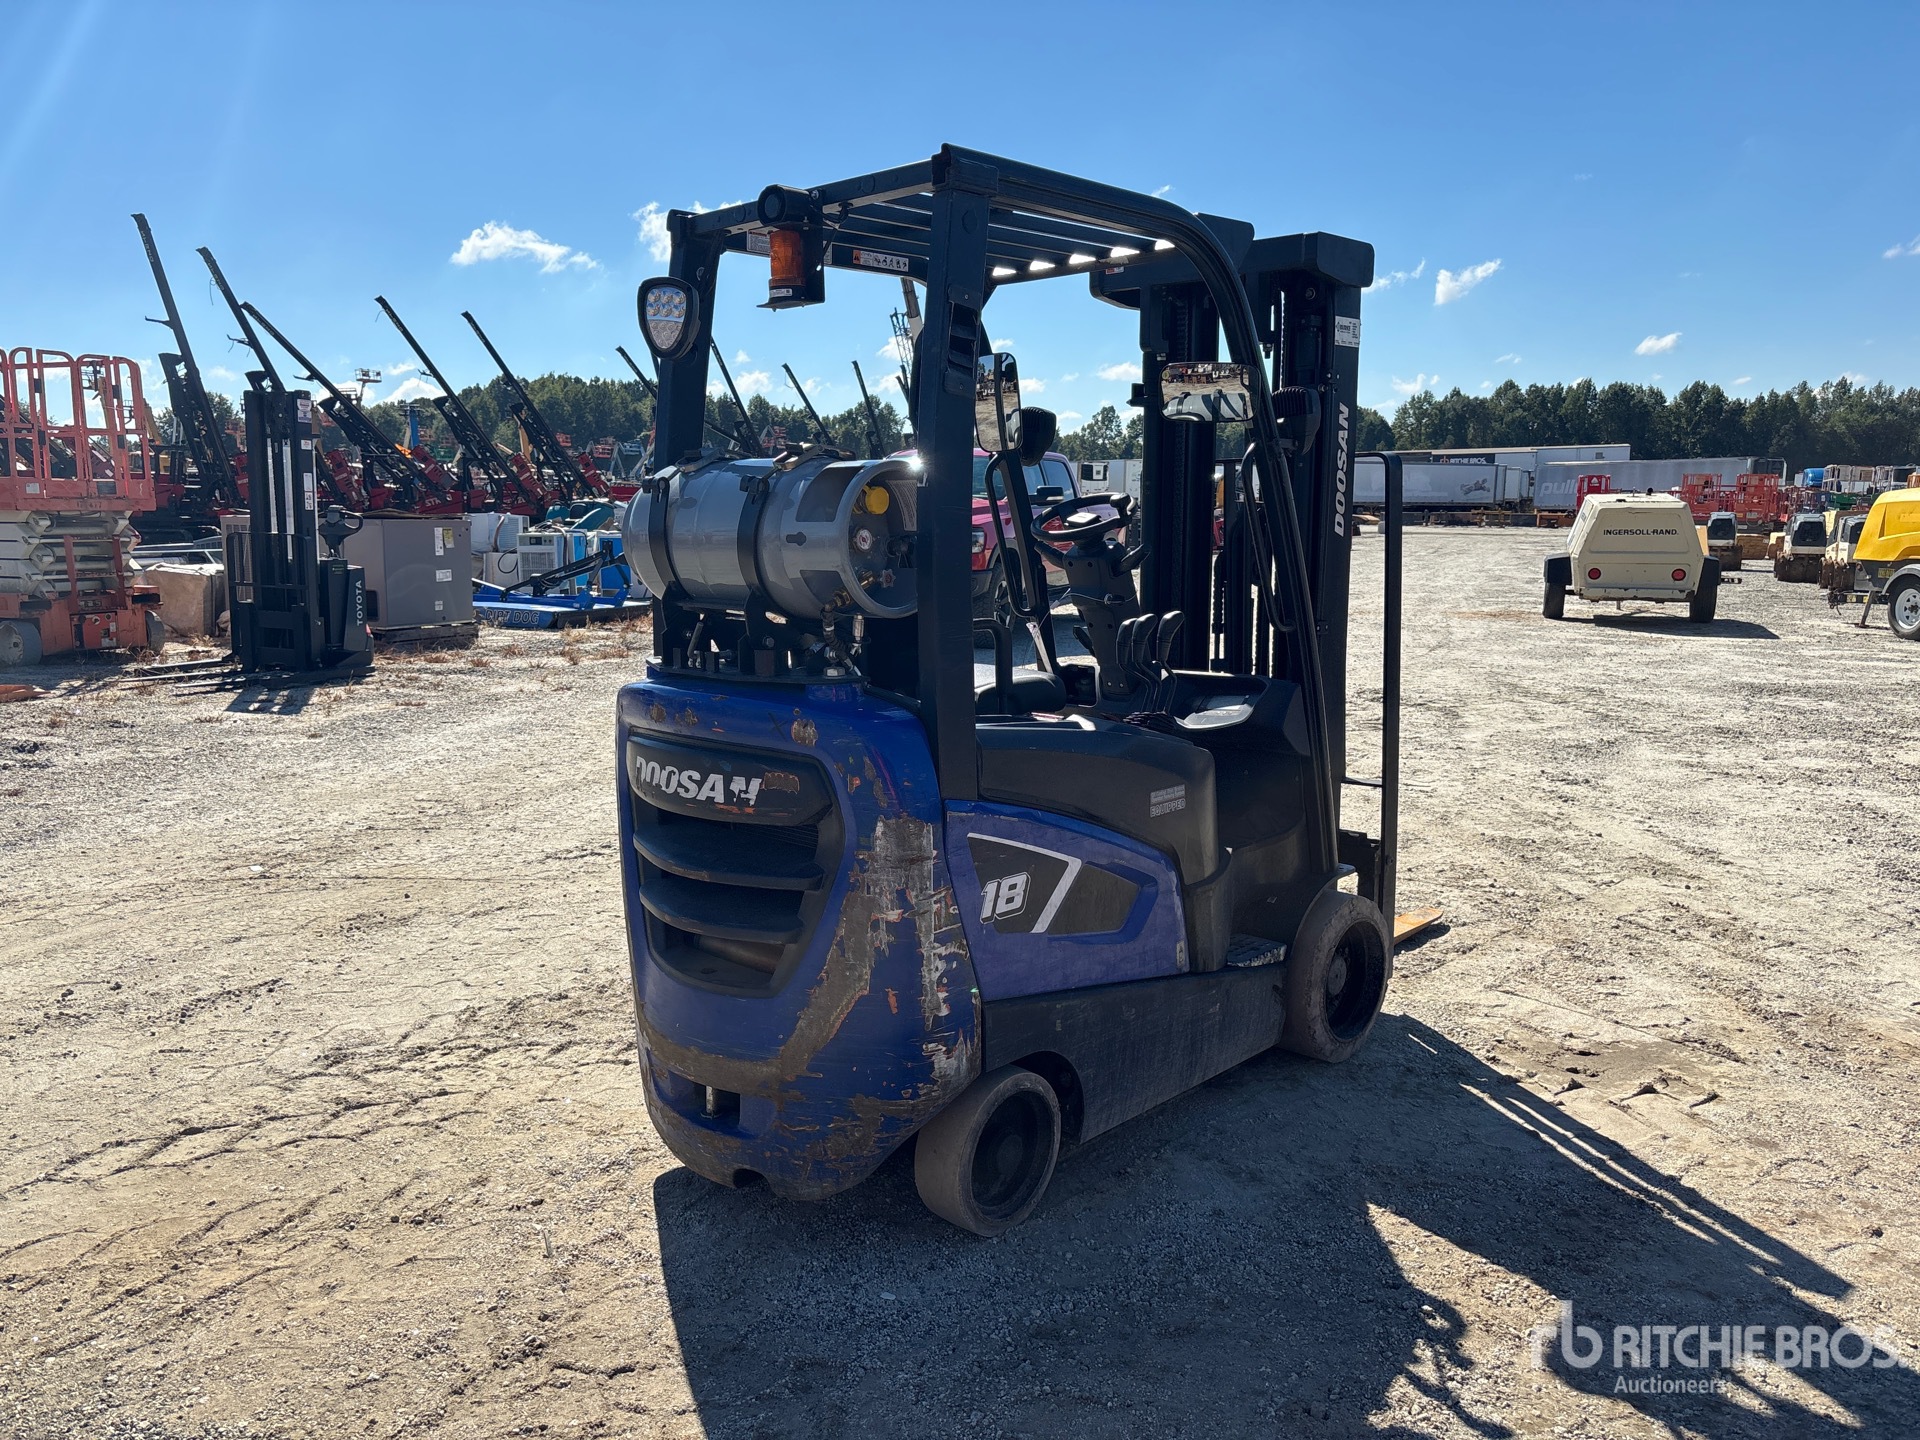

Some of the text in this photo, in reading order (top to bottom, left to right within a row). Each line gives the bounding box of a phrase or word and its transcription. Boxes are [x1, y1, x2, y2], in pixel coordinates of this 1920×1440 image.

[1334, 401, 1349, 537] DOOSAN
[1603, 528, 1679, 536] INGERSOLL-RAND
[355, 579, 363, 626] TOYOTA
[512, 610, 540, 625] DOG
[1150, 798, 1186, 818] EQUIPPED
[980, 871, 1031, 924] 18
